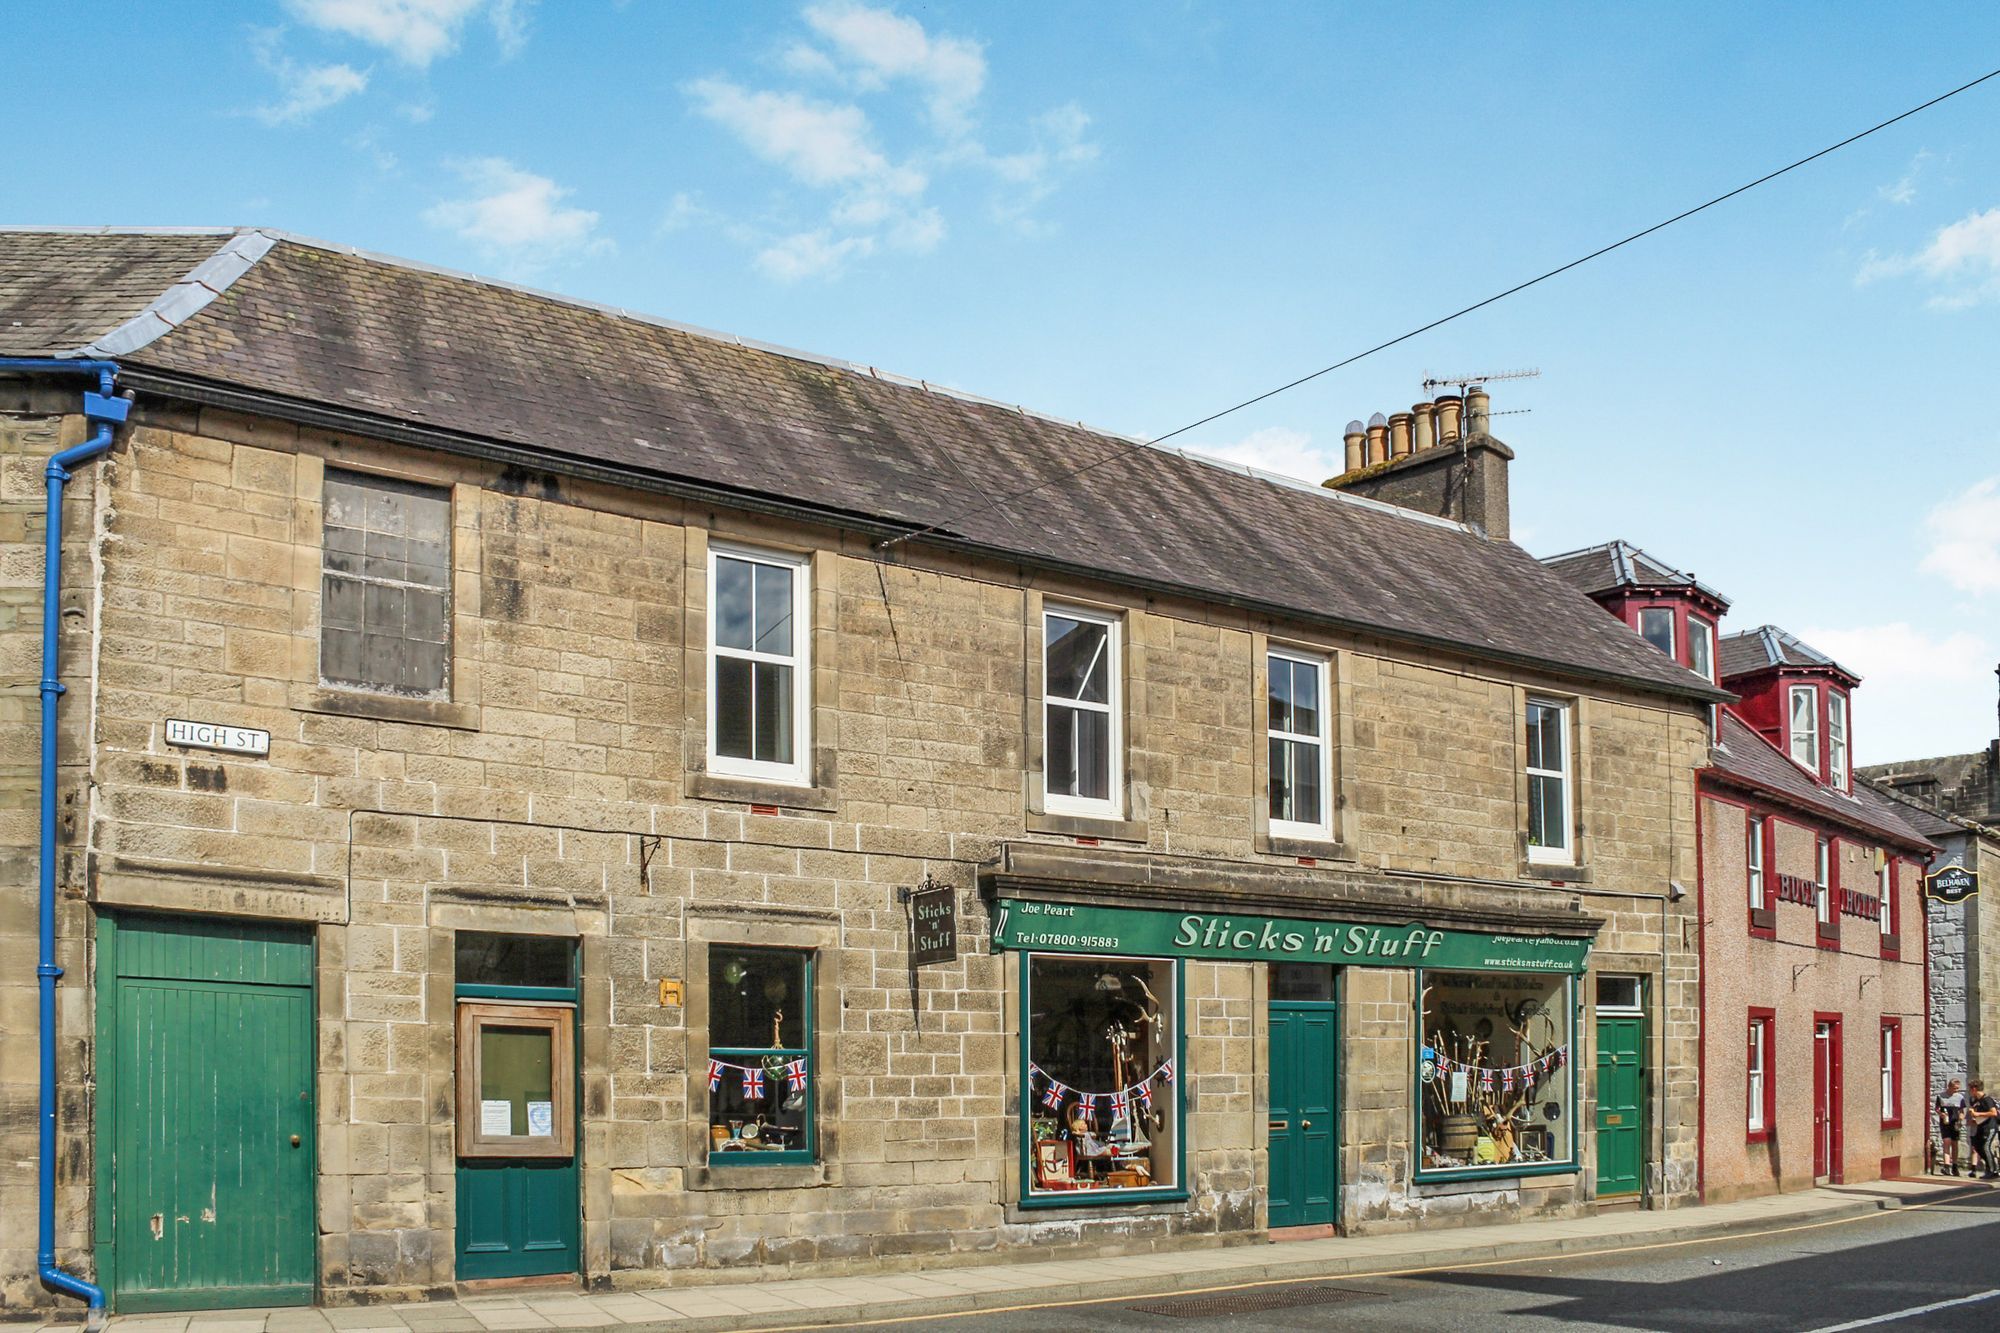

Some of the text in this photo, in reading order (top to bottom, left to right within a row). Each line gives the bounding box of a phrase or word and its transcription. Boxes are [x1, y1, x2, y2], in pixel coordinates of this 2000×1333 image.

[172, 723, 260, 748] HIGH ST
[1936, 877, 1970, 888] BELHAVEN
[1780, 873, 1881, 920] BUCK HOTEL
[918, 901, 952, 920] Sticks
[1020, 902, 1076, 917] Joe Peart
[928, 919, 940, 930] 'n'
[920, 931, 951, 951] Stuff
[1174, 915, 1444, 958] Sticks 'n' Stuff
[1484, 957, 1574, 969] www.sticksnstuff.co.uk
